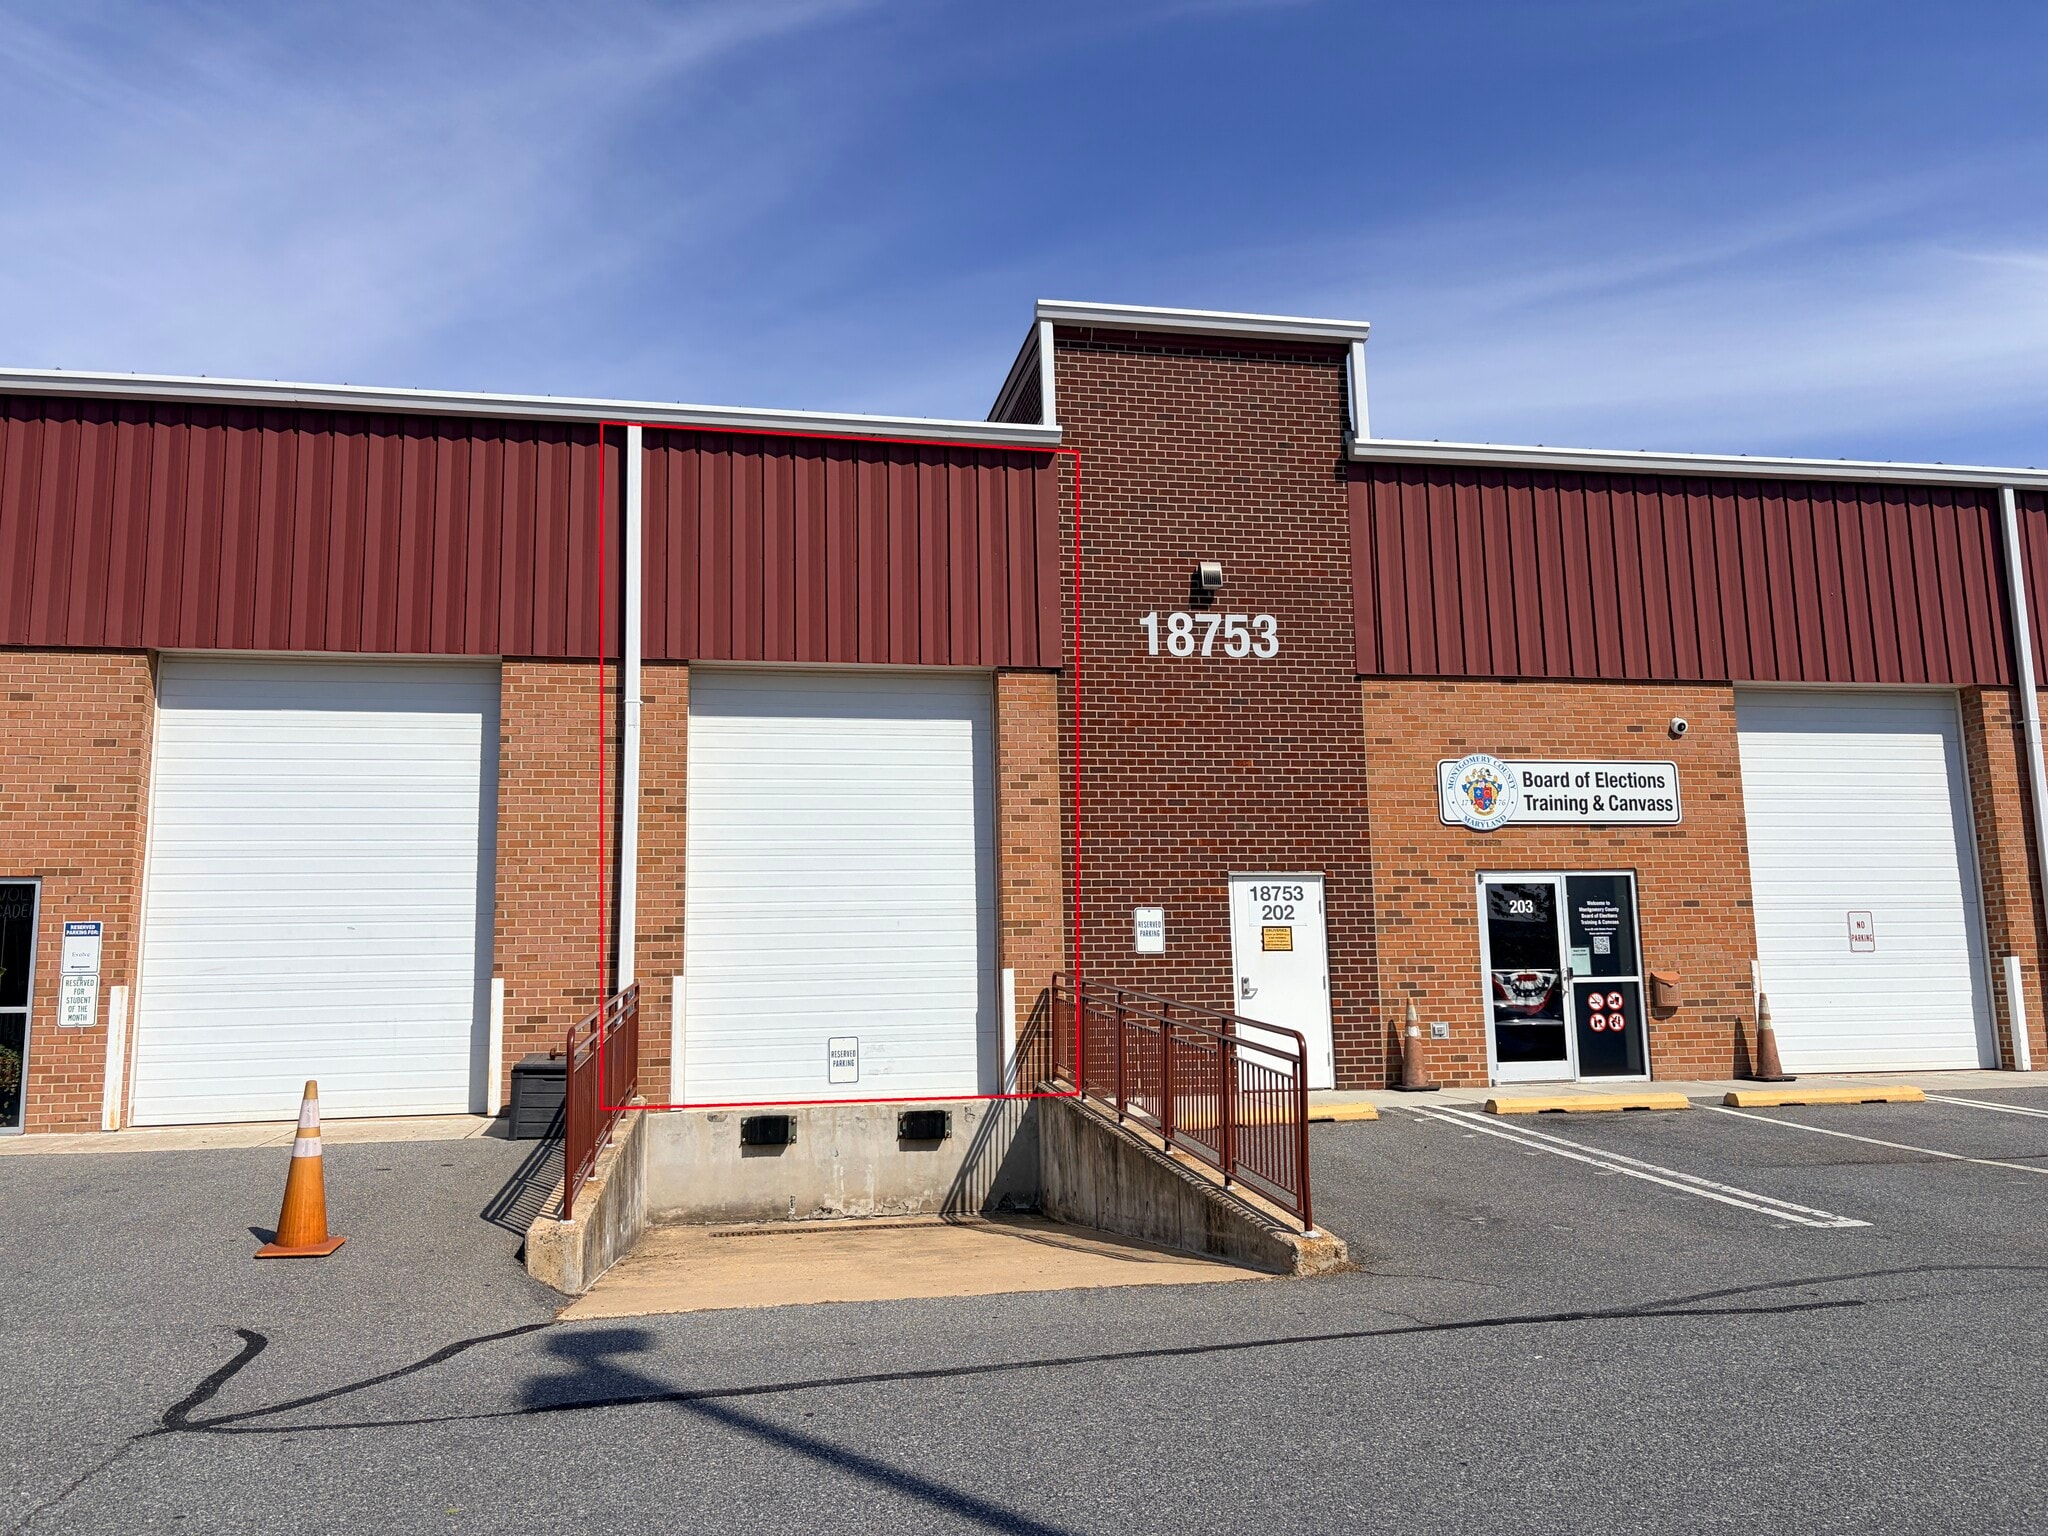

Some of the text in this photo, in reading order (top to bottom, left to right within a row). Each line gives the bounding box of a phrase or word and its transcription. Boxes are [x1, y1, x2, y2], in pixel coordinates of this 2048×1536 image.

[1139, 612, 1279, 658] 18753
[1448, 755, 1517, 790] MONTGOMERY COUNTY
[1522, 771, 1665, 789] Board of Elections
[1523, 794, 1674, 815] Training & Canvass
[1463, 814, 1507, 828] MARYLAND
[1250, 886, 1304, 901] 18753
[1509, 900, 1533, 914] 203
[1262, 904, 1295, 920] 202
[1137, 920, 1161, 929] RESERVED
[1139, 929, 1160, 938] PARKING
[1851, 934, 1873, 942] PARKING
[65, 979, 95, 987] RESERVED
[73, 987, 85, 996] FOR
[66, 996, 91, 1004] STUDENT
[67, 1005, 88, 1013] OF THE
[67, 1013, 88, 1021] MONTH
[831, 1050, 856, 1058] RESERVED
[833, 1059, 854, 1067] PARKING
